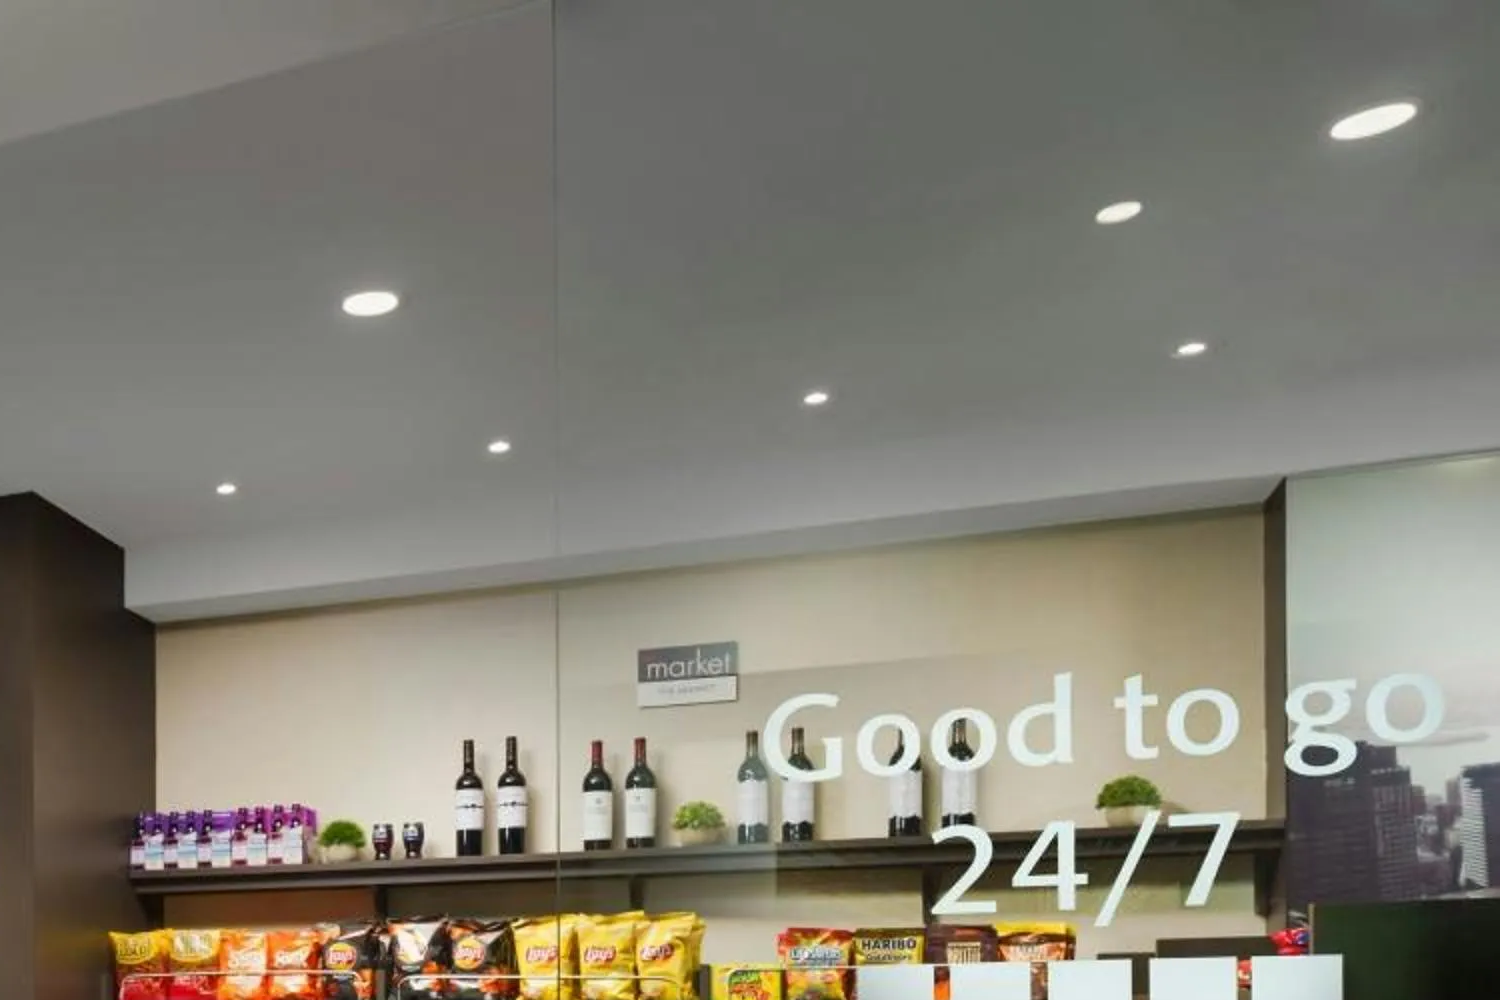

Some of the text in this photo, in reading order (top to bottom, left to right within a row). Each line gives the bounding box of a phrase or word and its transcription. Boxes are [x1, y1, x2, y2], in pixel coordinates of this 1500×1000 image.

[646, 647, 730, 679] market
[763, 671, 1445, 783] Good to go
[932, 810, 1241, 927] 24/7
[861, 938, 917, 951] HARIBO
